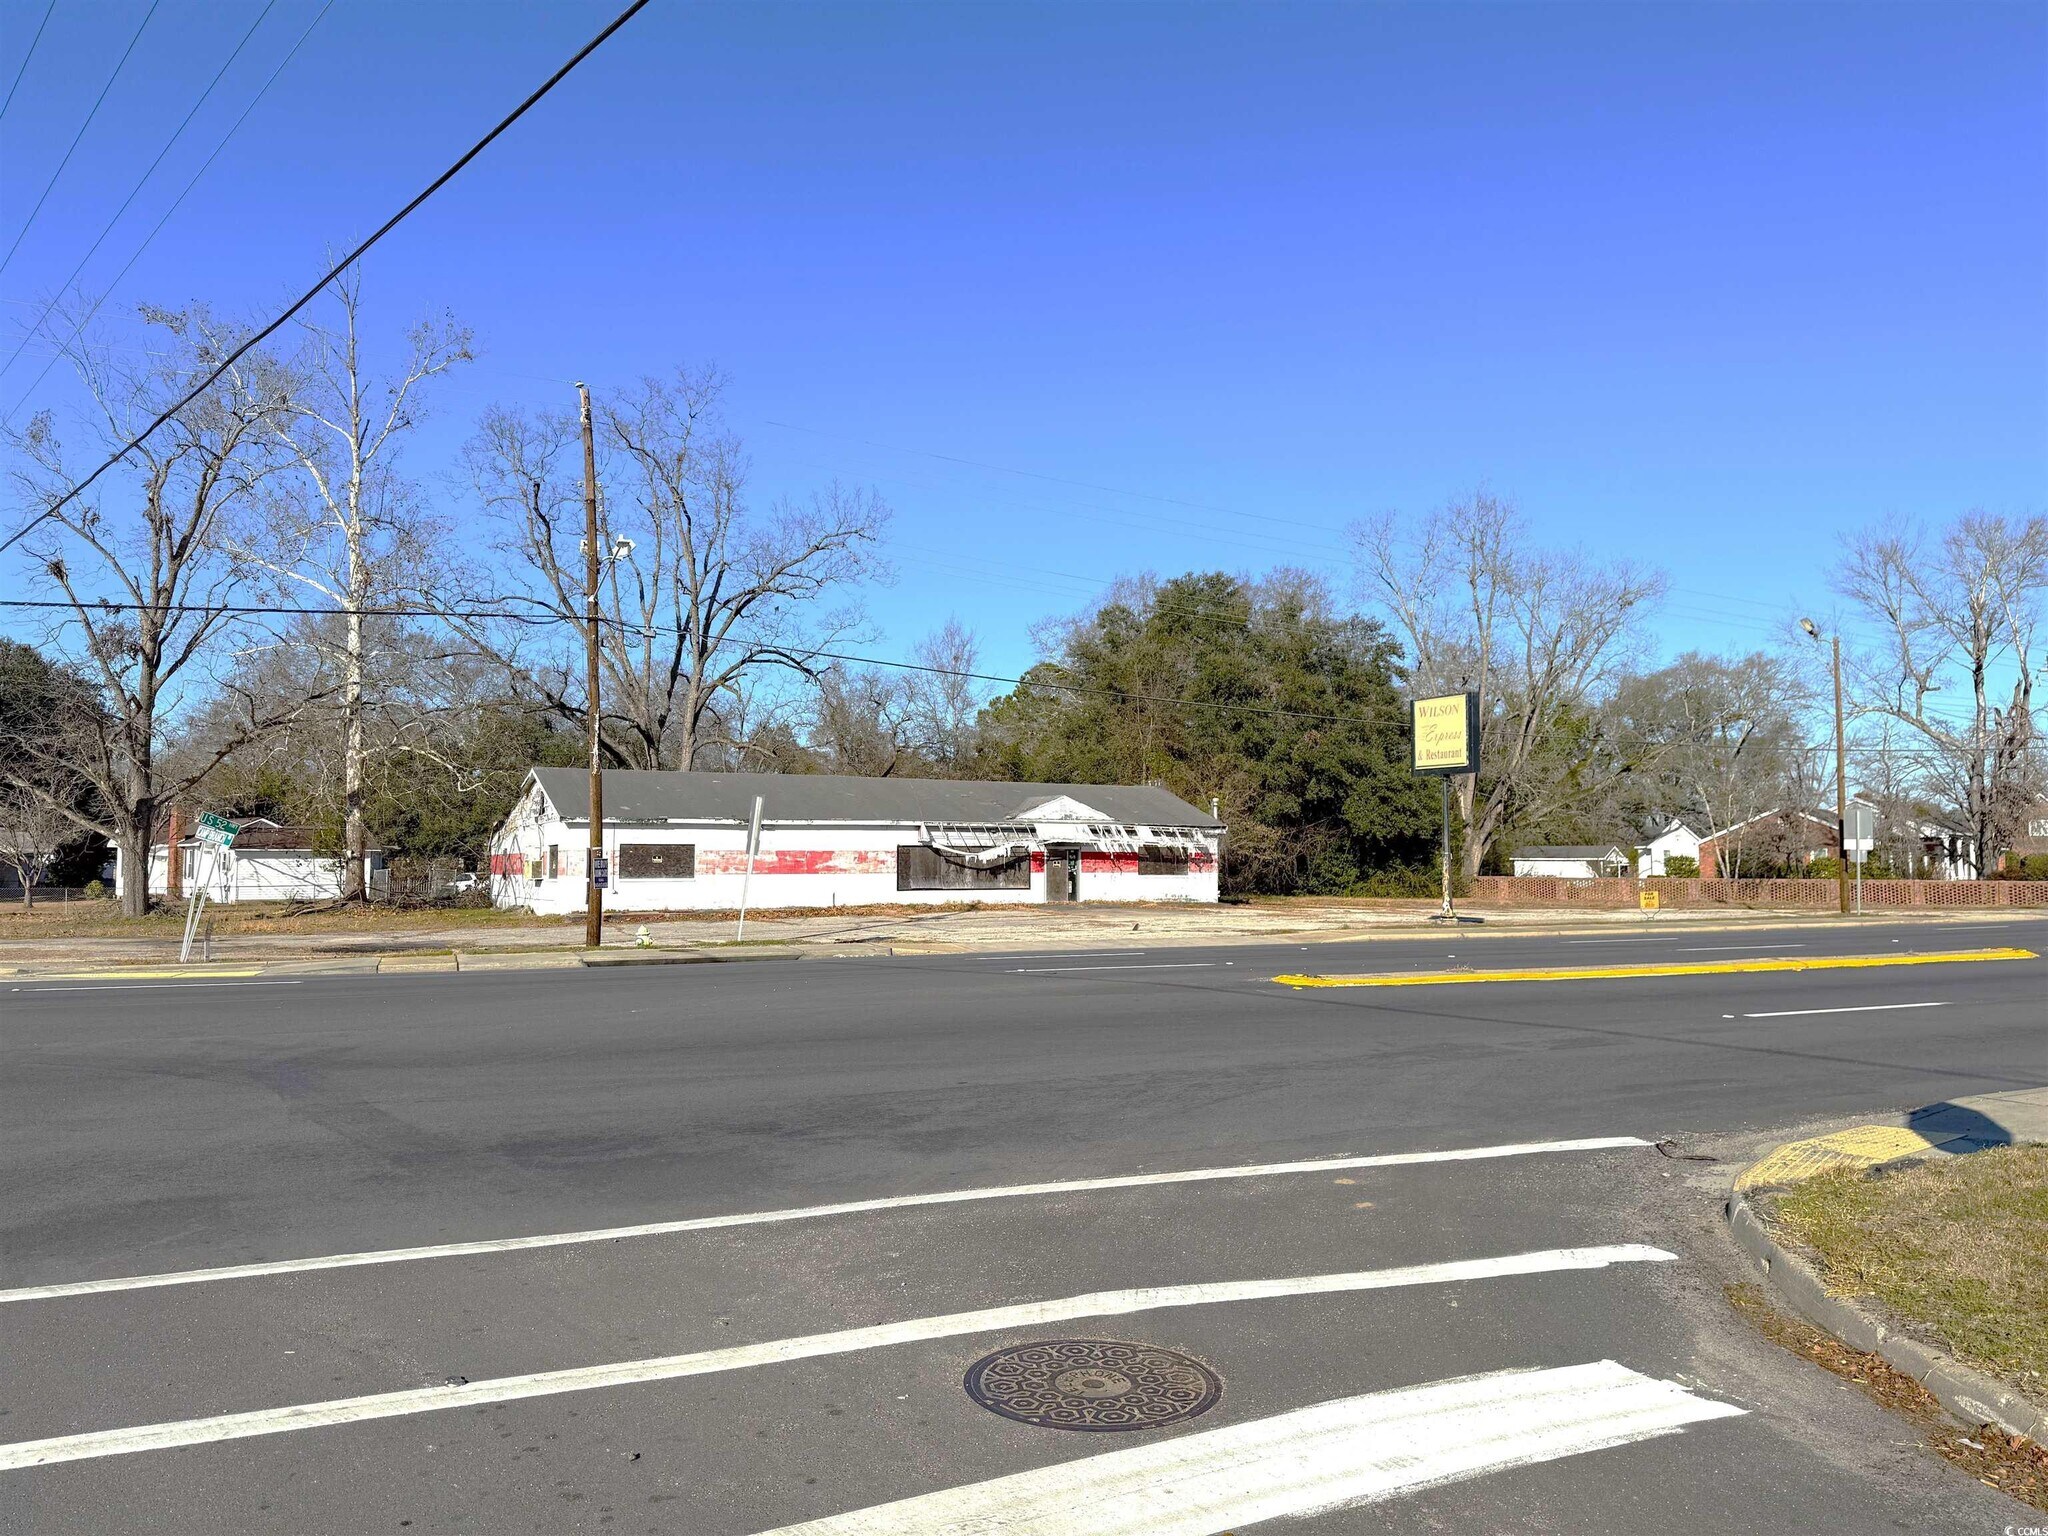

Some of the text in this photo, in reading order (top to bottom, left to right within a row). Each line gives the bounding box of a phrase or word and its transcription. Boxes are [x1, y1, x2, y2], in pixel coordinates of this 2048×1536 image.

[1419, 704, 1459, 718] WILSON
[1425, 724, 1462, 746] Express
[1417, 749, 1462, 761] & Restaurant
[200, 812, 215, 825] US
[215, 818, 228, 830] 52
